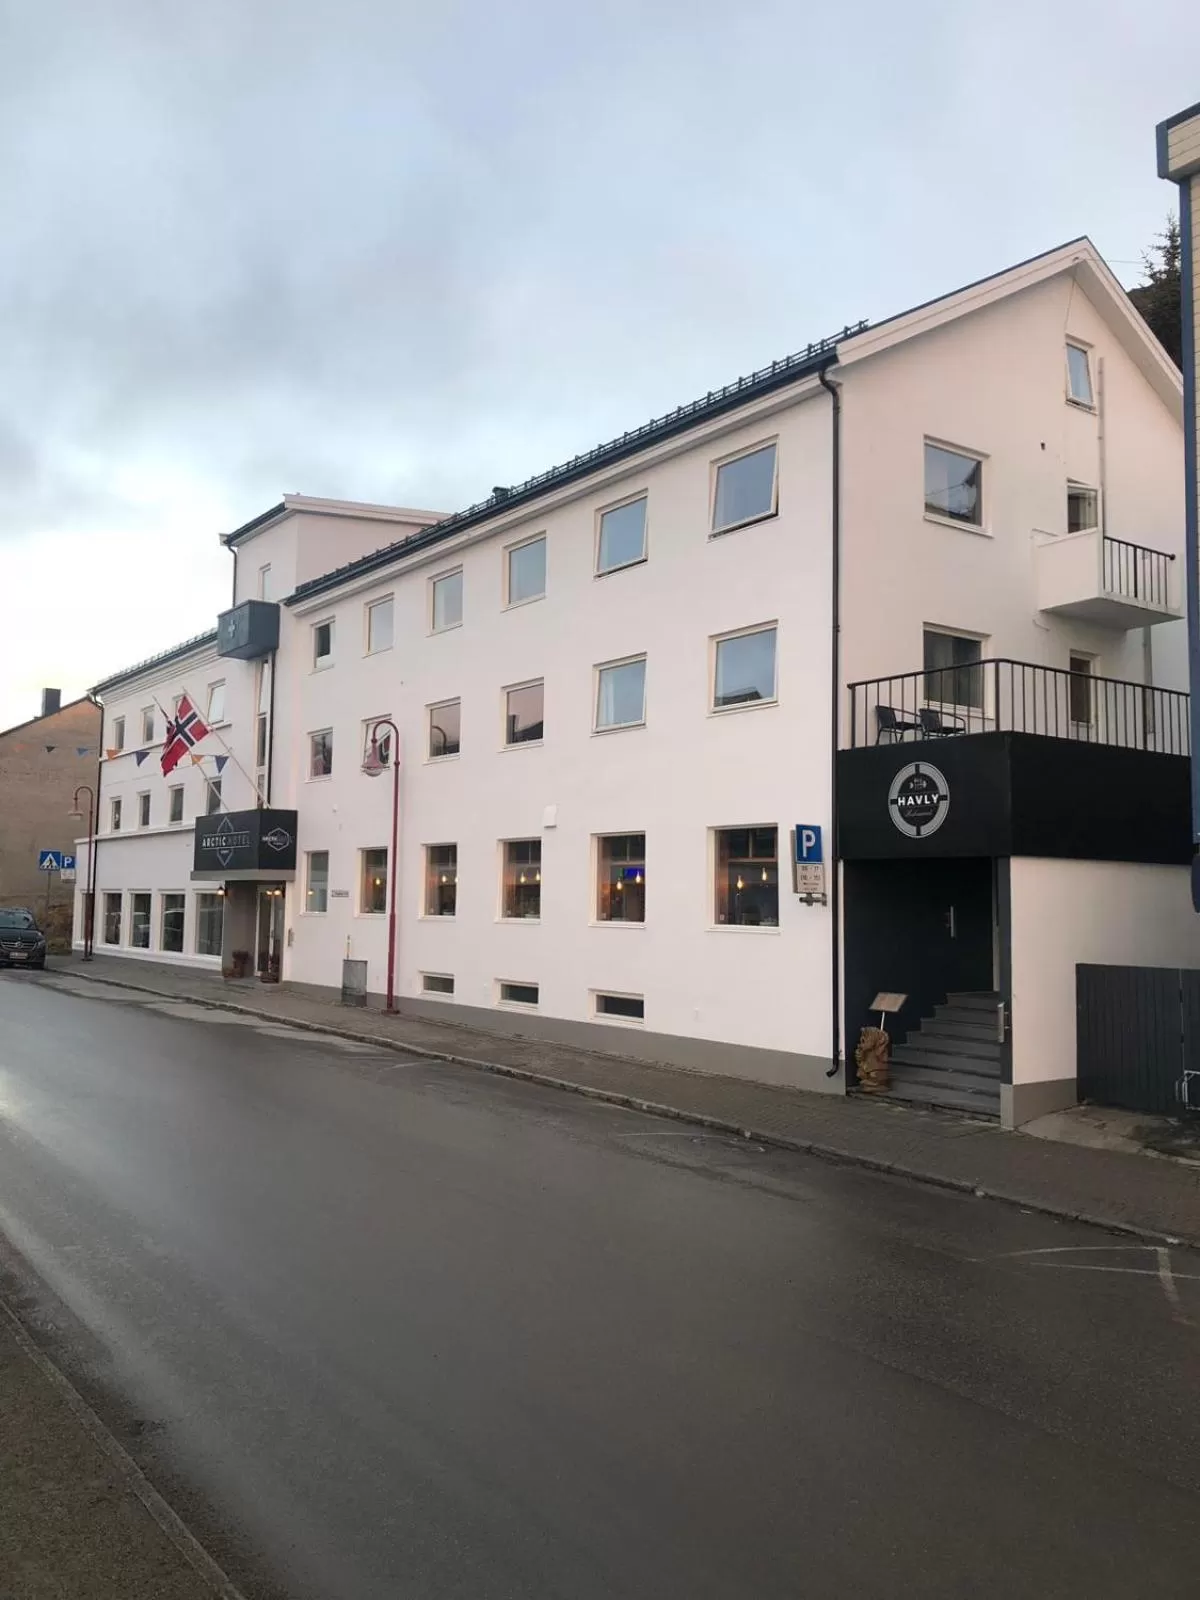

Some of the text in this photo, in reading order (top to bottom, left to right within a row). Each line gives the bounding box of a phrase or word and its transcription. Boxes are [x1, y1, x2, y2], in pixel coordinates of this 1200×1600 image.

[897, 793, 939, 806] HAVLY
[202, 836, 226, 848] ARCTIC
[802, 829, 816, 858] P
[64, 857, 73, 868] P
